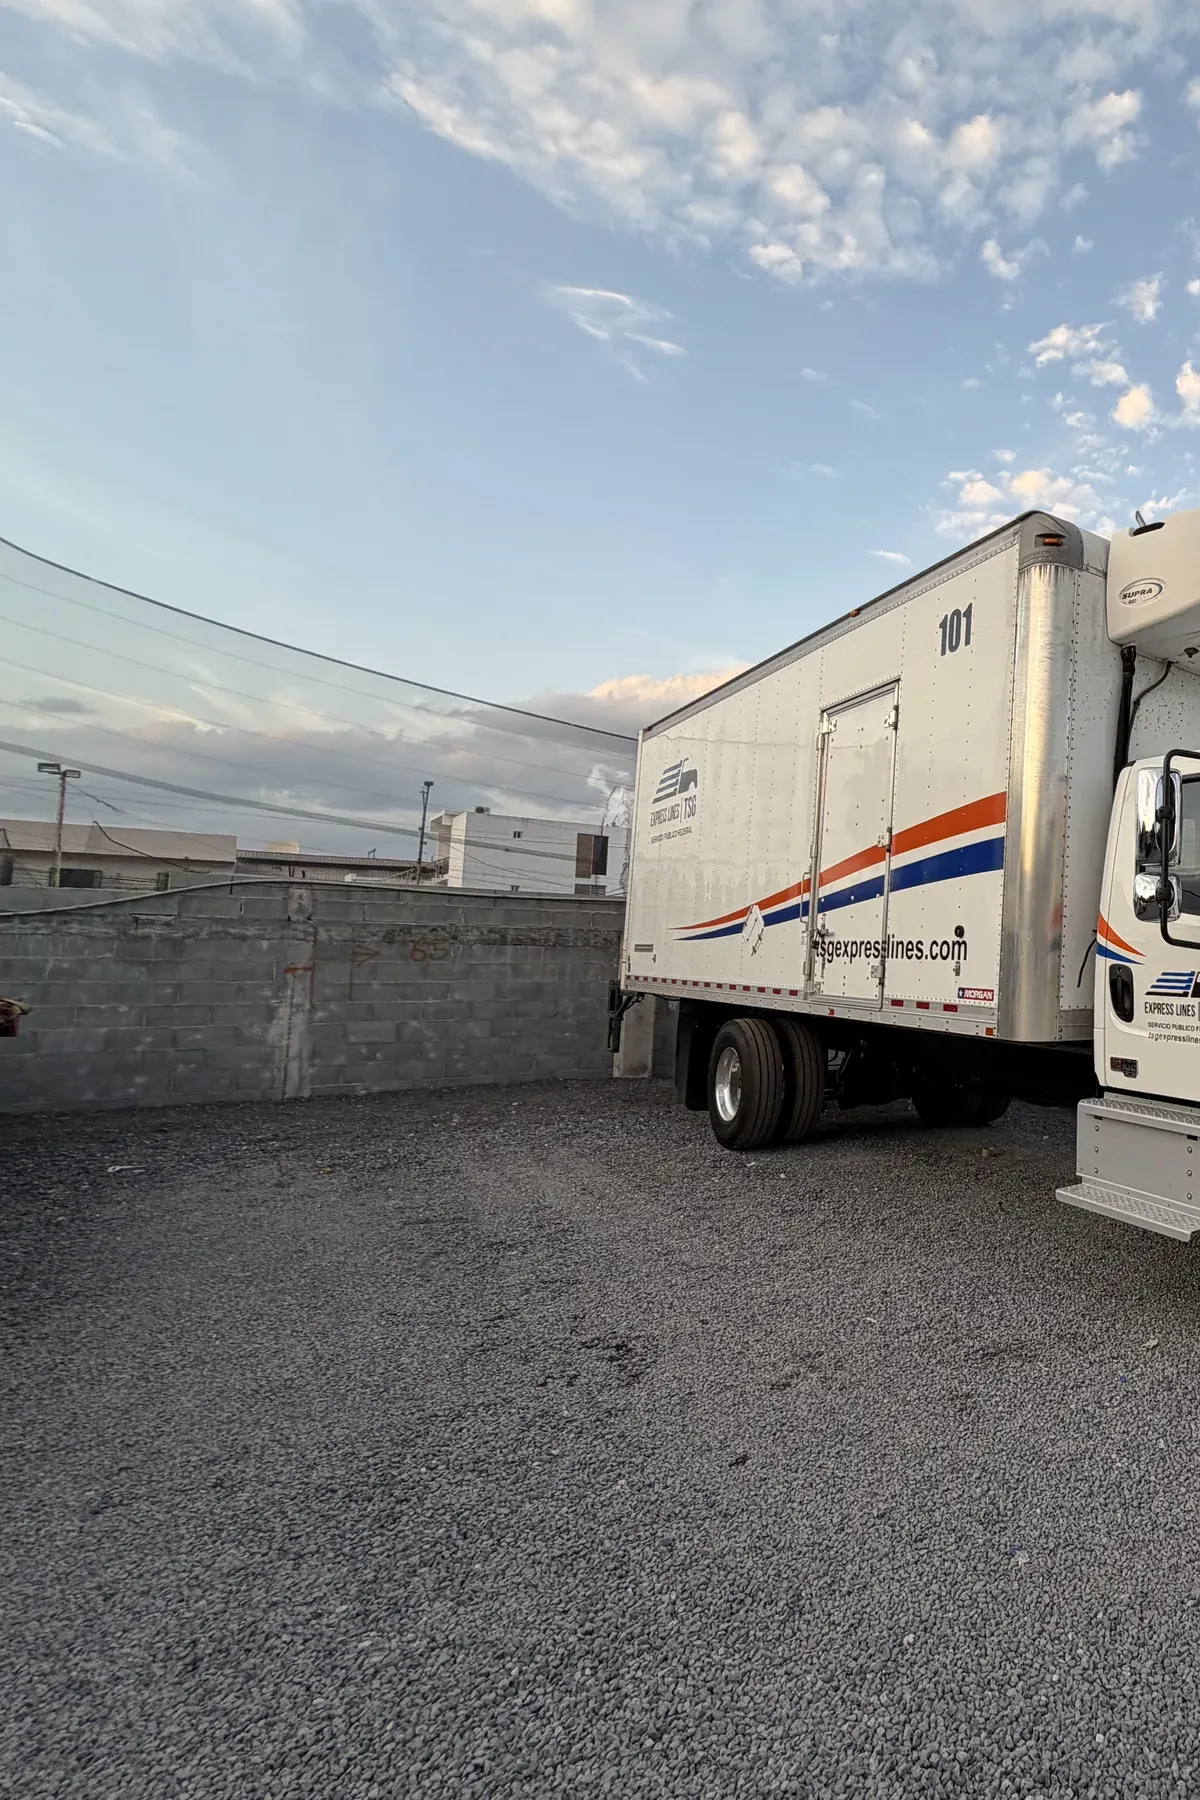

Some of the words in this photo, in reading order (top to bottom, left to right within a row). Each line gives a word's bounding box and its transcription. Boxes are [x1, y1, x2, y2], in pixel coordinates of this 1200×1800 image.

[1121, 588, 1153, 600] SUPRA
[938, 602, 973, 657] 101
[684, 794, 697, 820] TSG
[964, 989, 994, 1000] MORGAN
[1144, 1001, 1174, 1016] EXPRESS
[1175, 1003, 1196, 1017] LINES
[1147, 1021, 1171, 1030] SERVICIO
